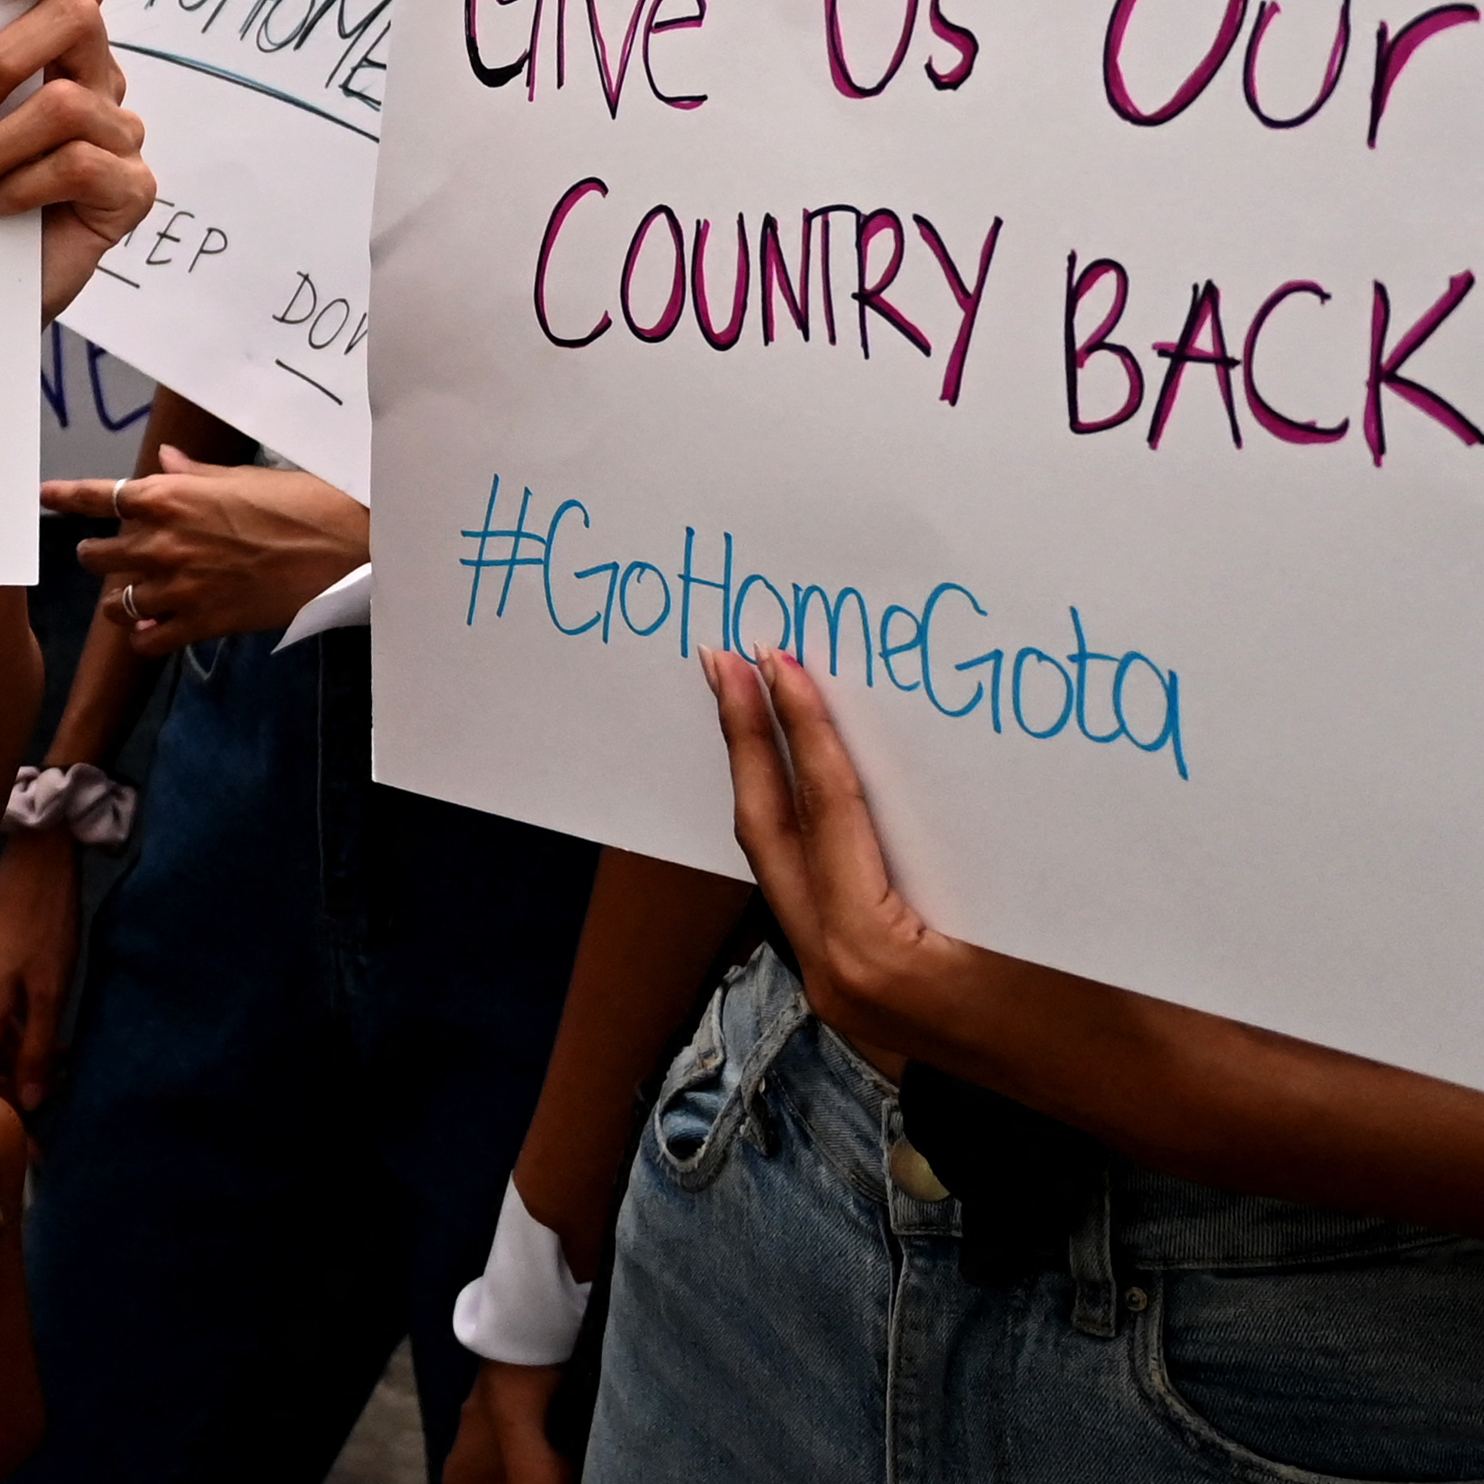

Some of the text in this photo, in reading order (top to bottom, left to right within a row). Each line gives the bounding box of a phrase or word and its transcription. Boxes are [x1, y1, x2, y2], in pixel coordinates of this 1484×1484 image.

[534, 176, 1484, 468] COUNTRY BACK
[458, 473, 1191, 781] #GoHomeGota
